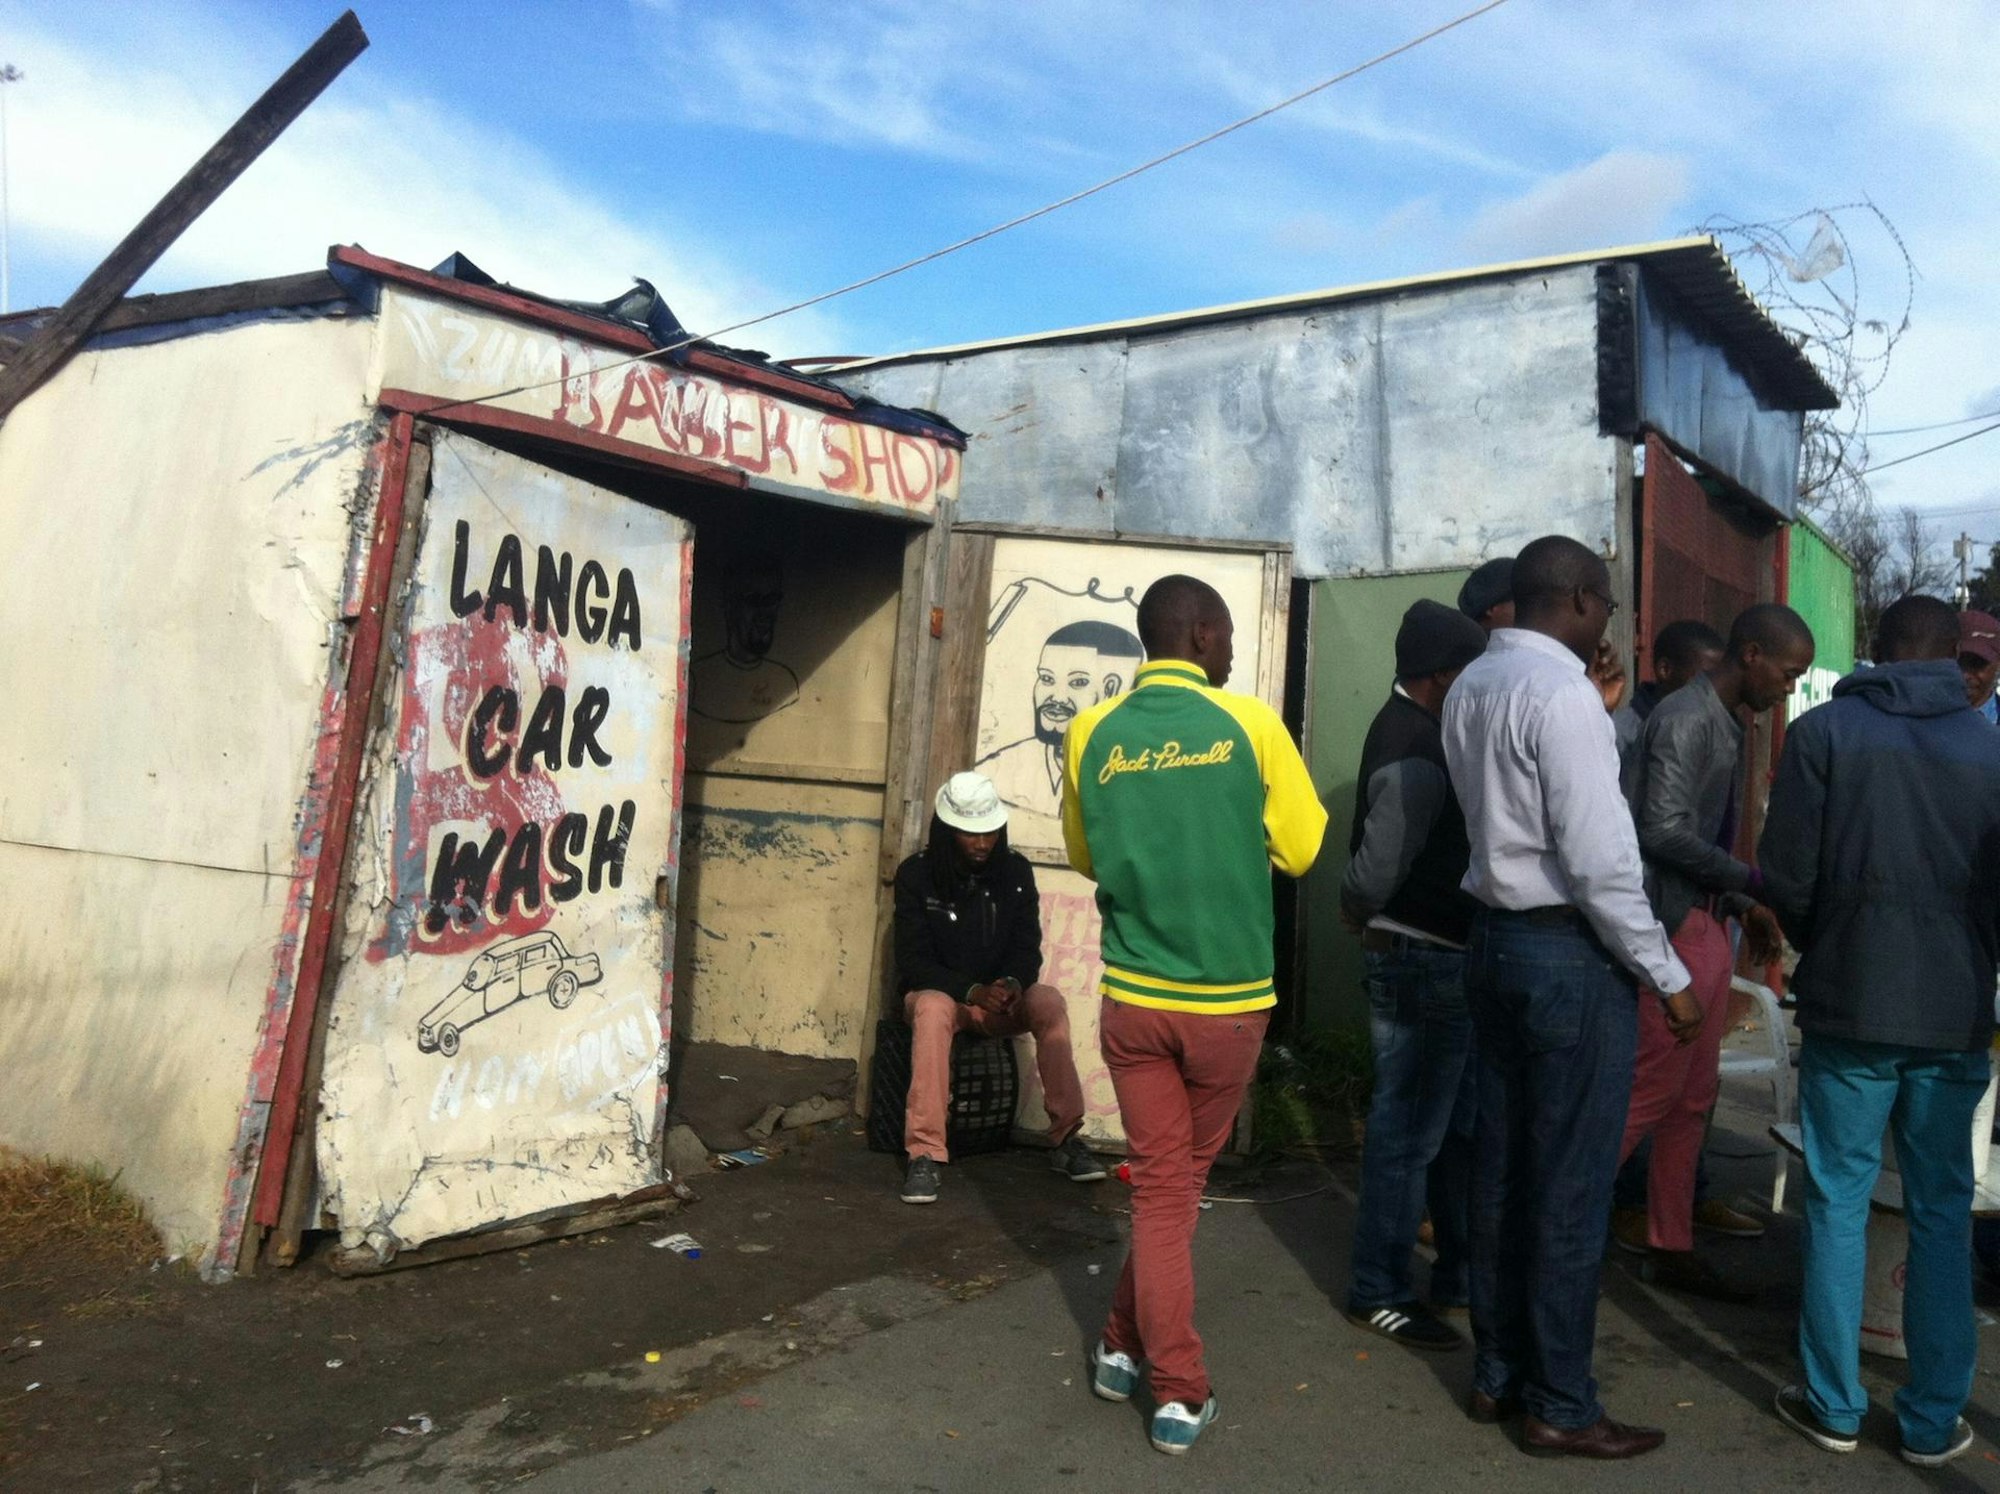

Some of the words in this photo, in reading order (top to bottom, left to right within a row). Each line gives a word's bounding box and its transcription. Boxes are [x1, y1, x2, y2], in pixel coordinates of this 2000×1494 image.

[819, 415, 954, 501] SHOP
[450, 519, 641, 651] LANGA
[467, 684, 612, 778] CAR
[1098, 745, 1149, 784] Jack
[1152, 740, 1234, 771] Purcell
[424, 799, 635, 933] WASH
